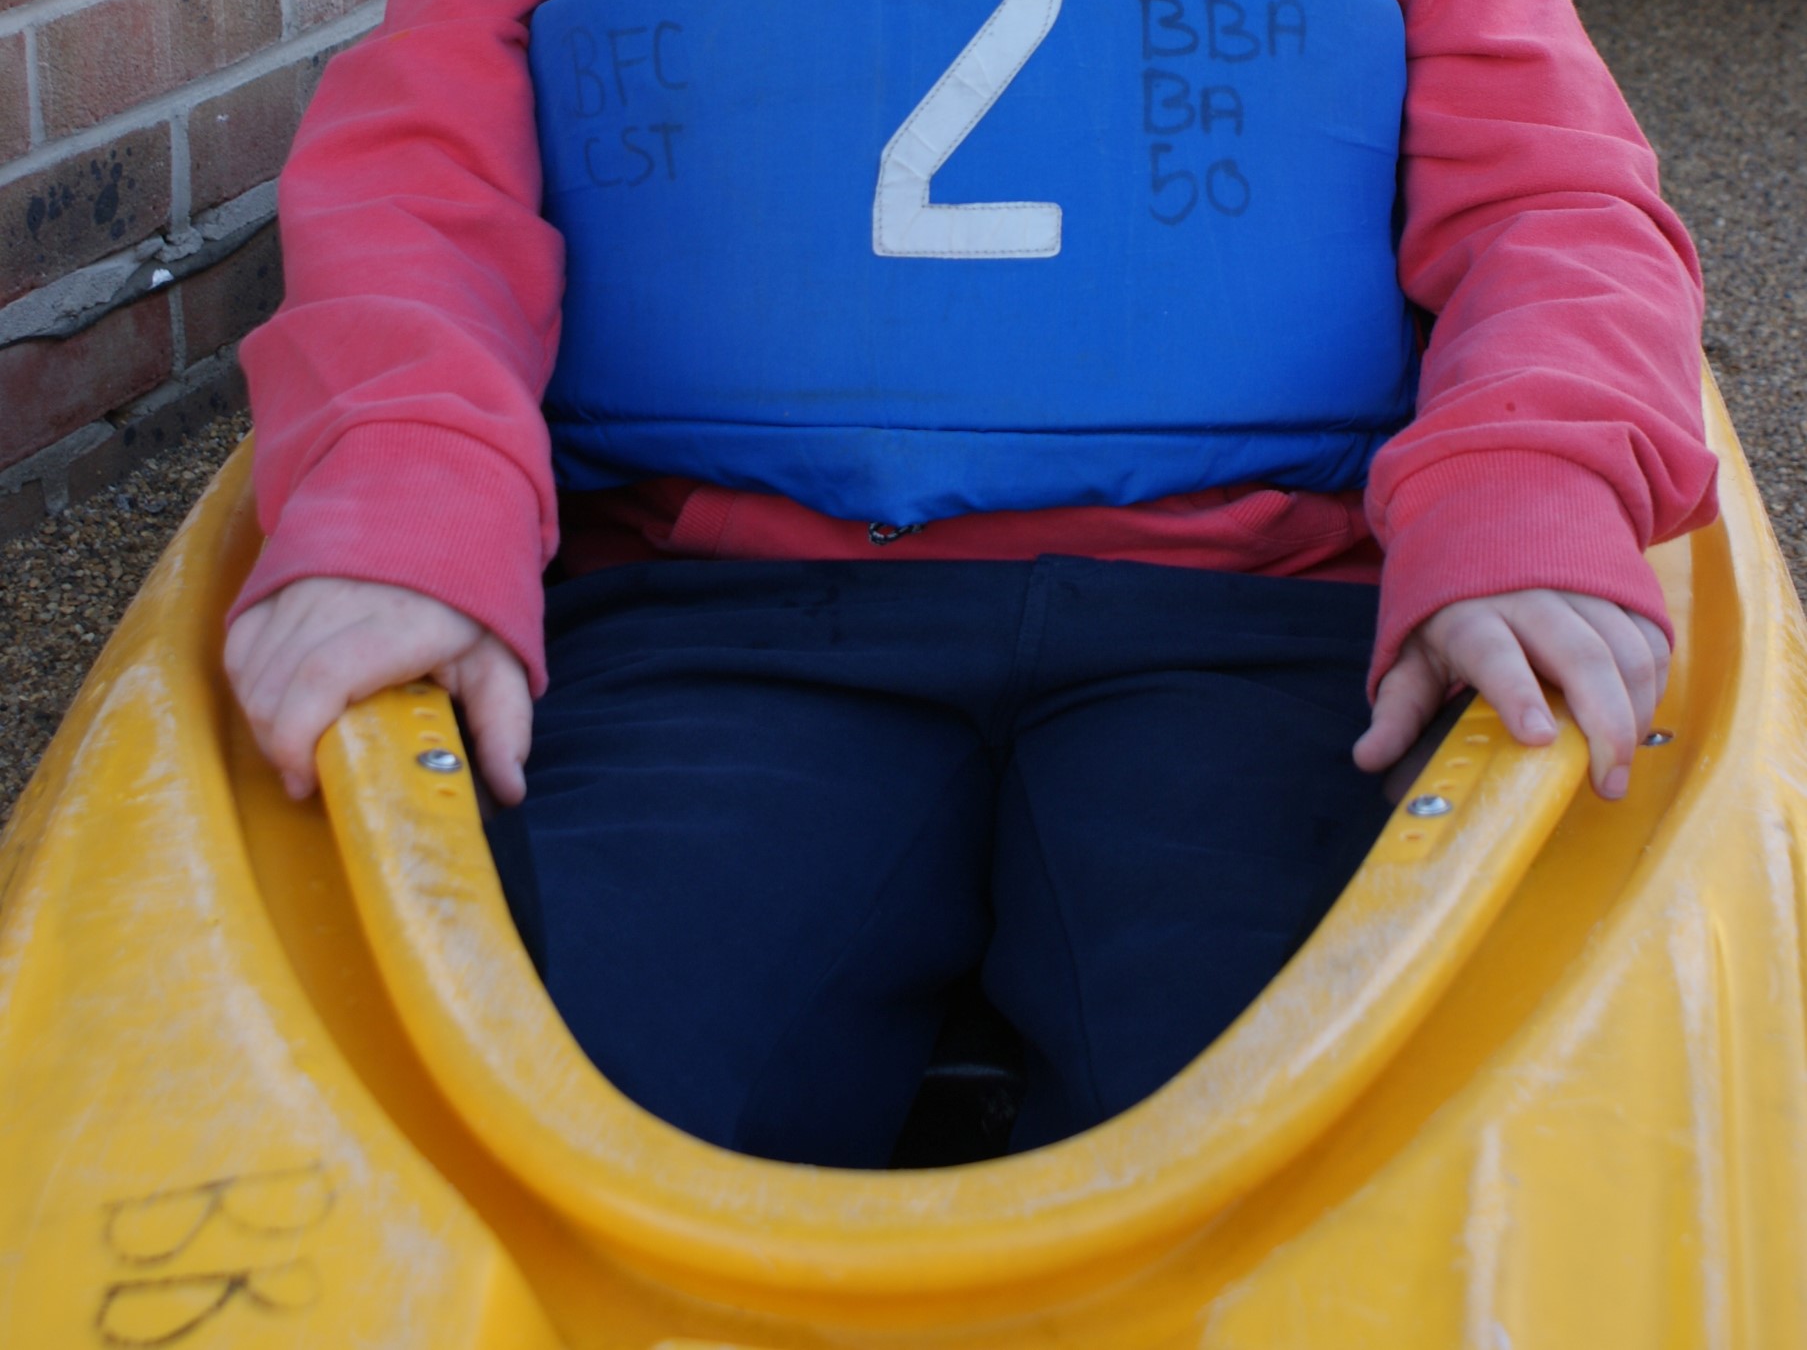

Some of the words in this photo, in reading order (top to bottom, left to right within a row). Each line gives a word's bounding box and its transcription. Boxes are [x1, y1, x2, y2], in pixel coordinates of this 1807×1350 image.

[561, 20, 689, 118] BFC
[1142, 67, 1244, 136] BA
[583, 121, 685, 188] CST
[1149, 142, 1250, 226] 50
